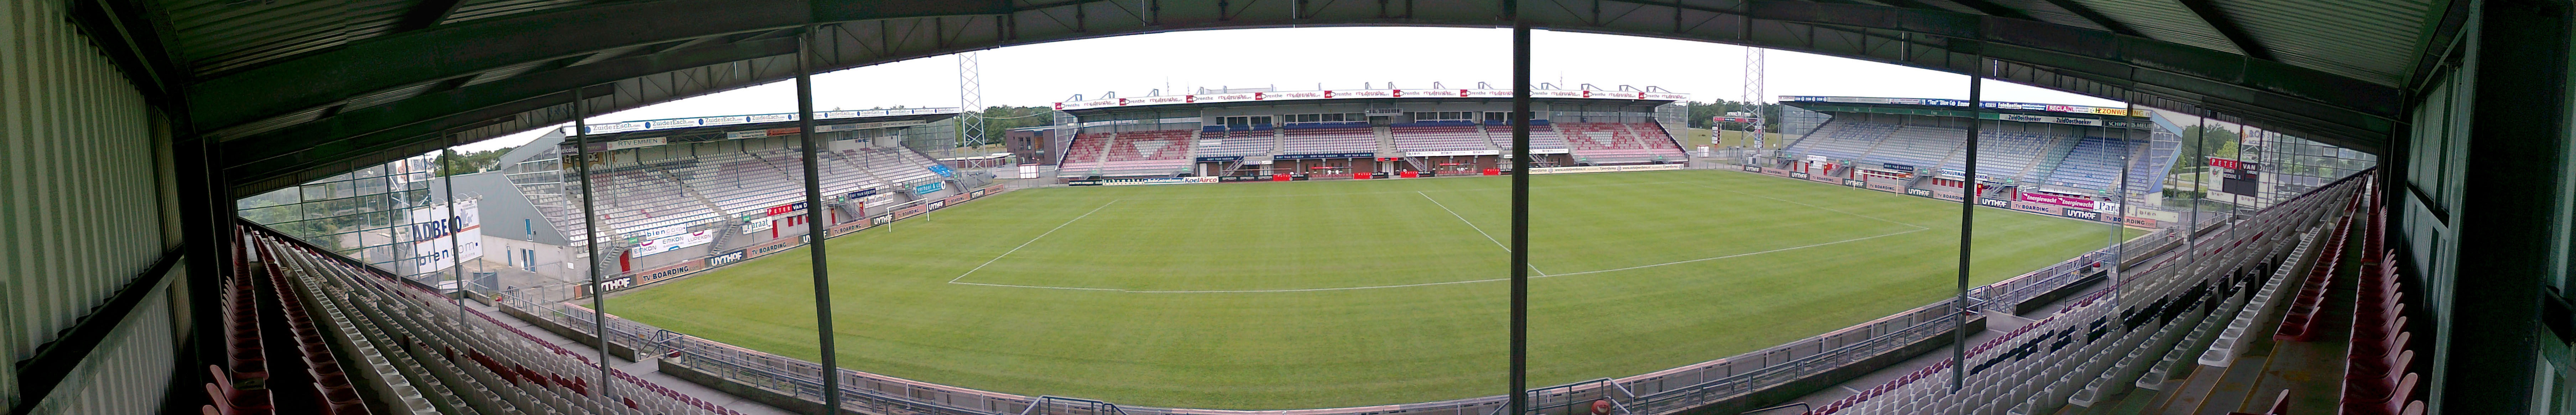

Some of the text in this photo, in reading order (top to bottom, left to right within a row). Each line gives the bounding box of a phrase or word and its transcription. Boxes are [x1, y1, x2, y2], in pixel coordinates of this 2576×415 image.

[1908, 188, 1930, 196] UYTHOF
[1982, 198, 2007, 208] UYTHOF
[2027, 195, 2057, 204] Energiewacht
[2062, 199, 2093, 208] Energiewacht
[929, 201, 943, 210] UYTHOF
[2067, 209, 2097, 220] UYTHOF
[2113, 217, 2154, 226] BORDING.com
[688, 234, 712, 243] LUPEKON
[634, 245, 656, 254] EMKON
[711, 251, 742, 267] UYTHOF
